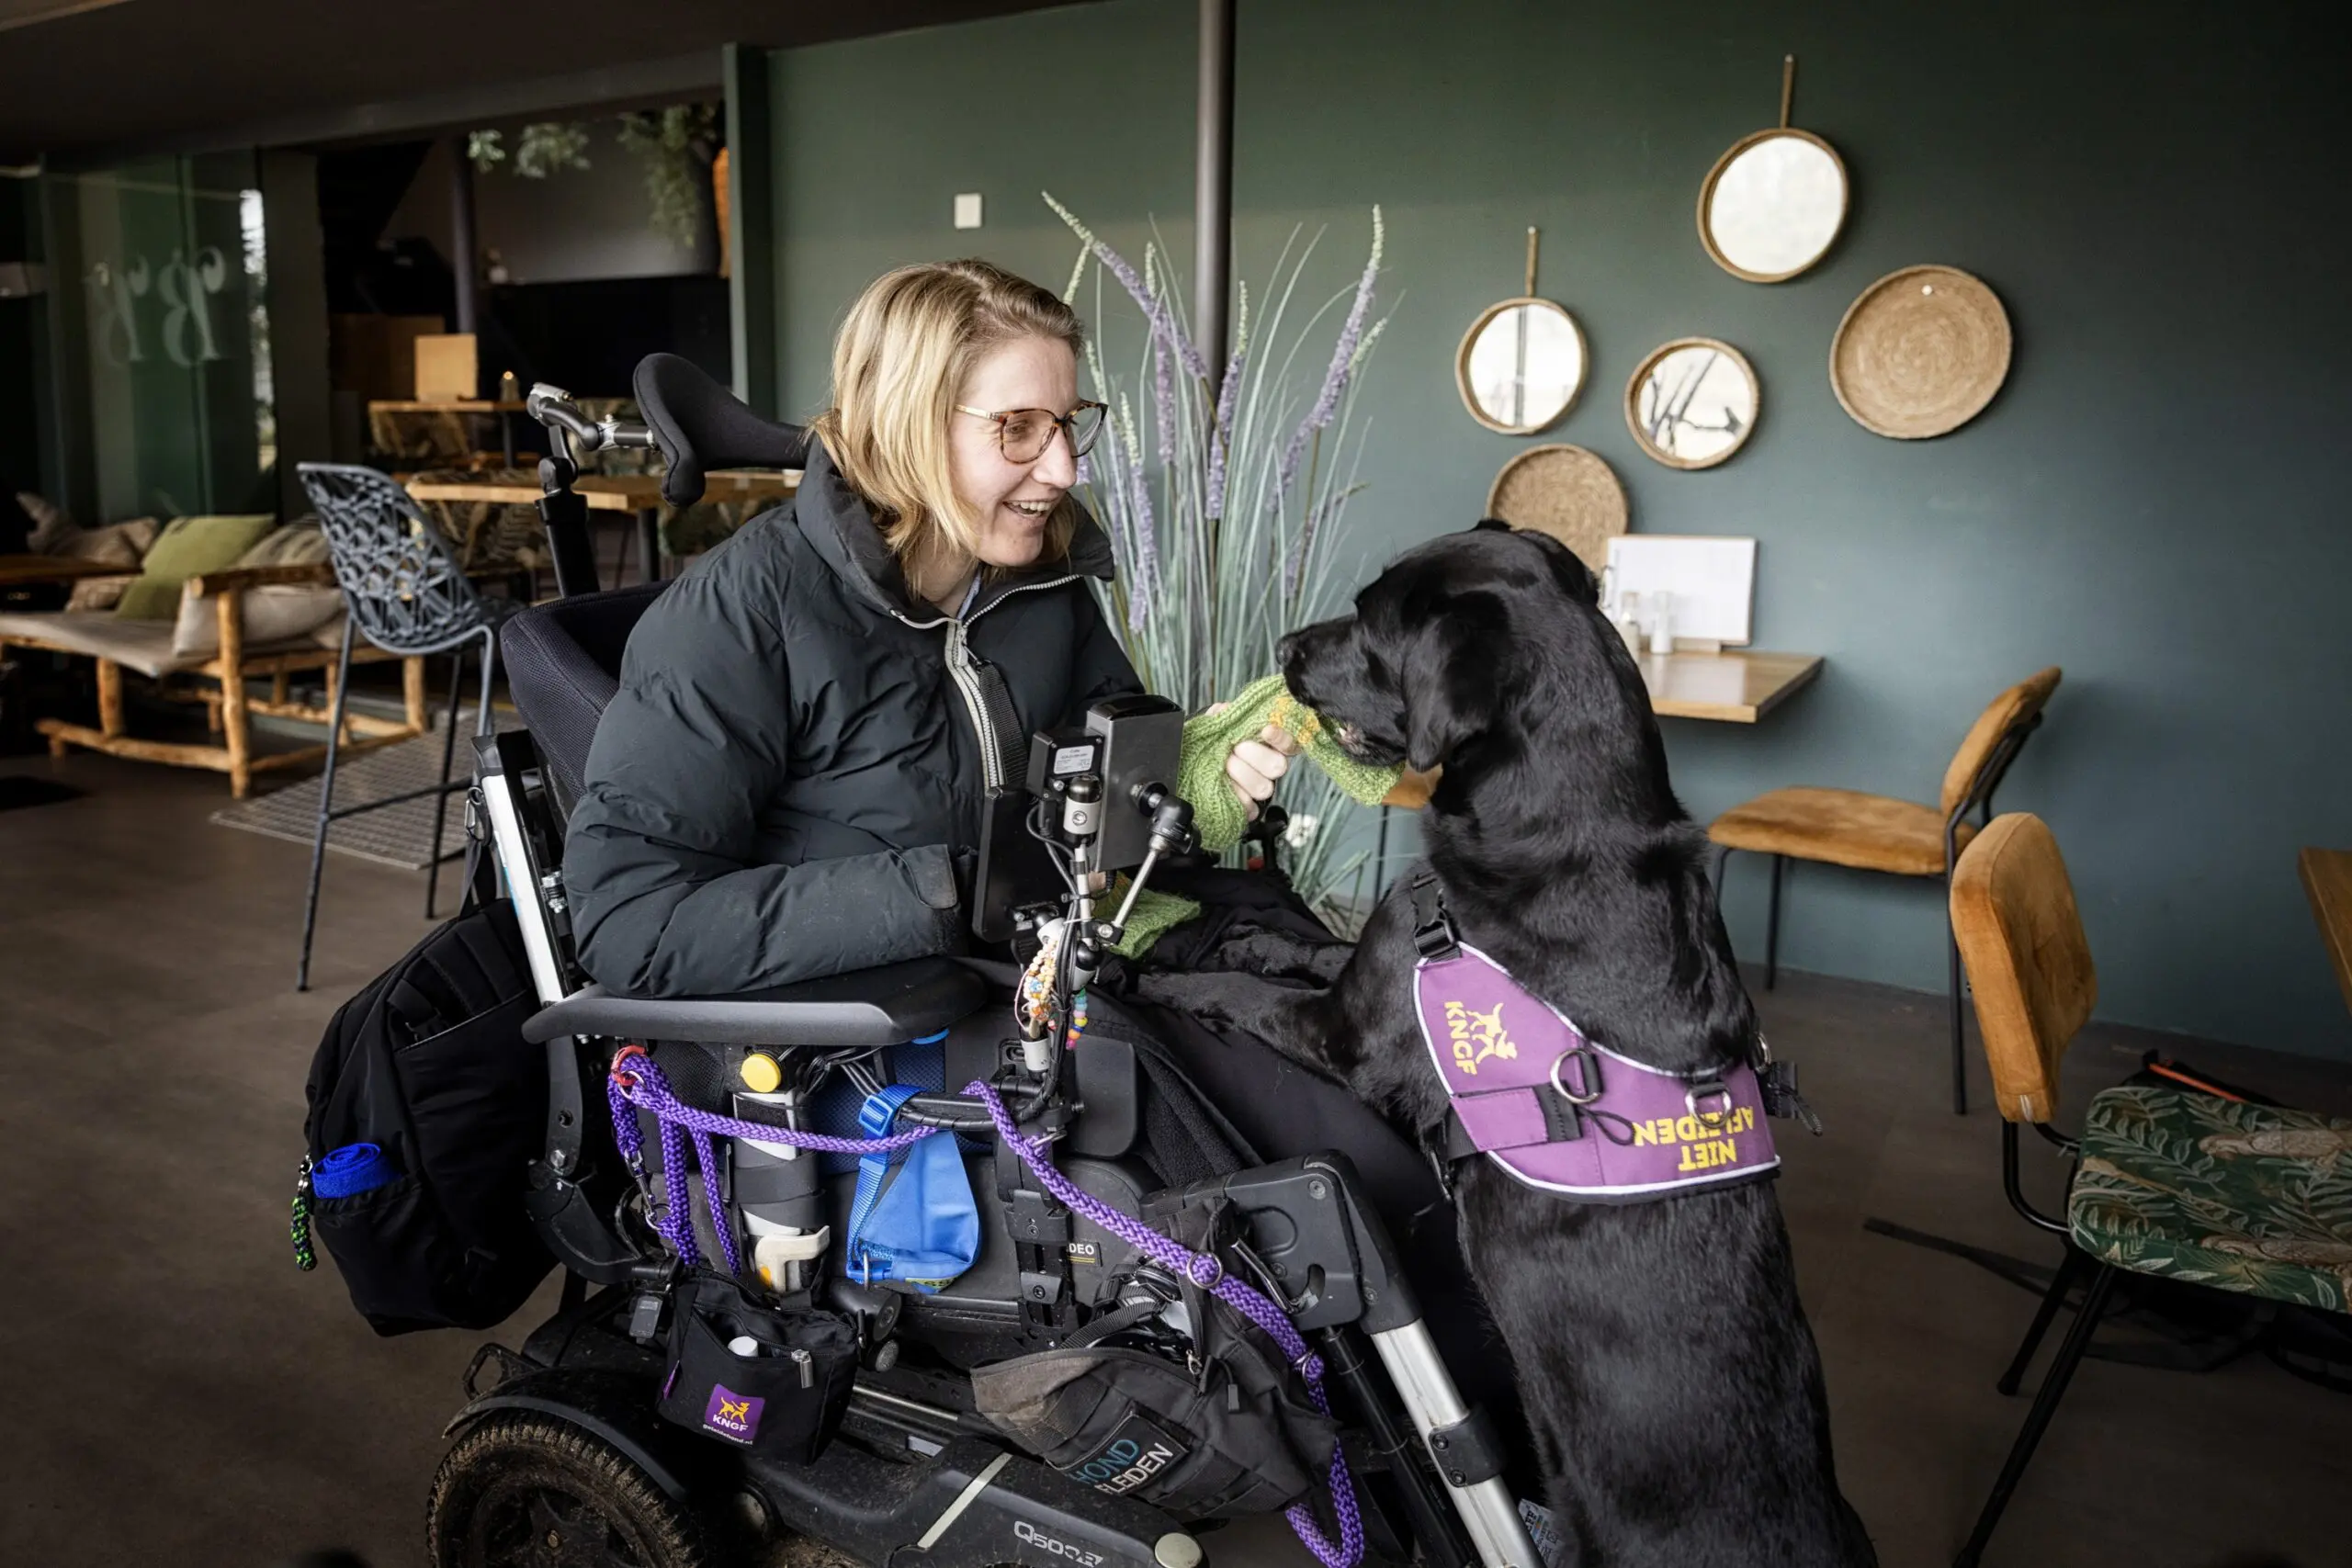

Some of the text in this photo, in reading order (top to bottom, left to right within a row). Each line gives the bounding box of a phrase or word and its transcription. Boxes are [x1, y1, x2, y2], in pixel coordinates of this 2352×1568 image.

[1444, 1001, 1477, 1075] KNGF
[1679, 1138, 1736, 1172] NIET
[1066, 1243, 1095, 1255] DEO
[713, 1415, 749, 1432] KNGF
